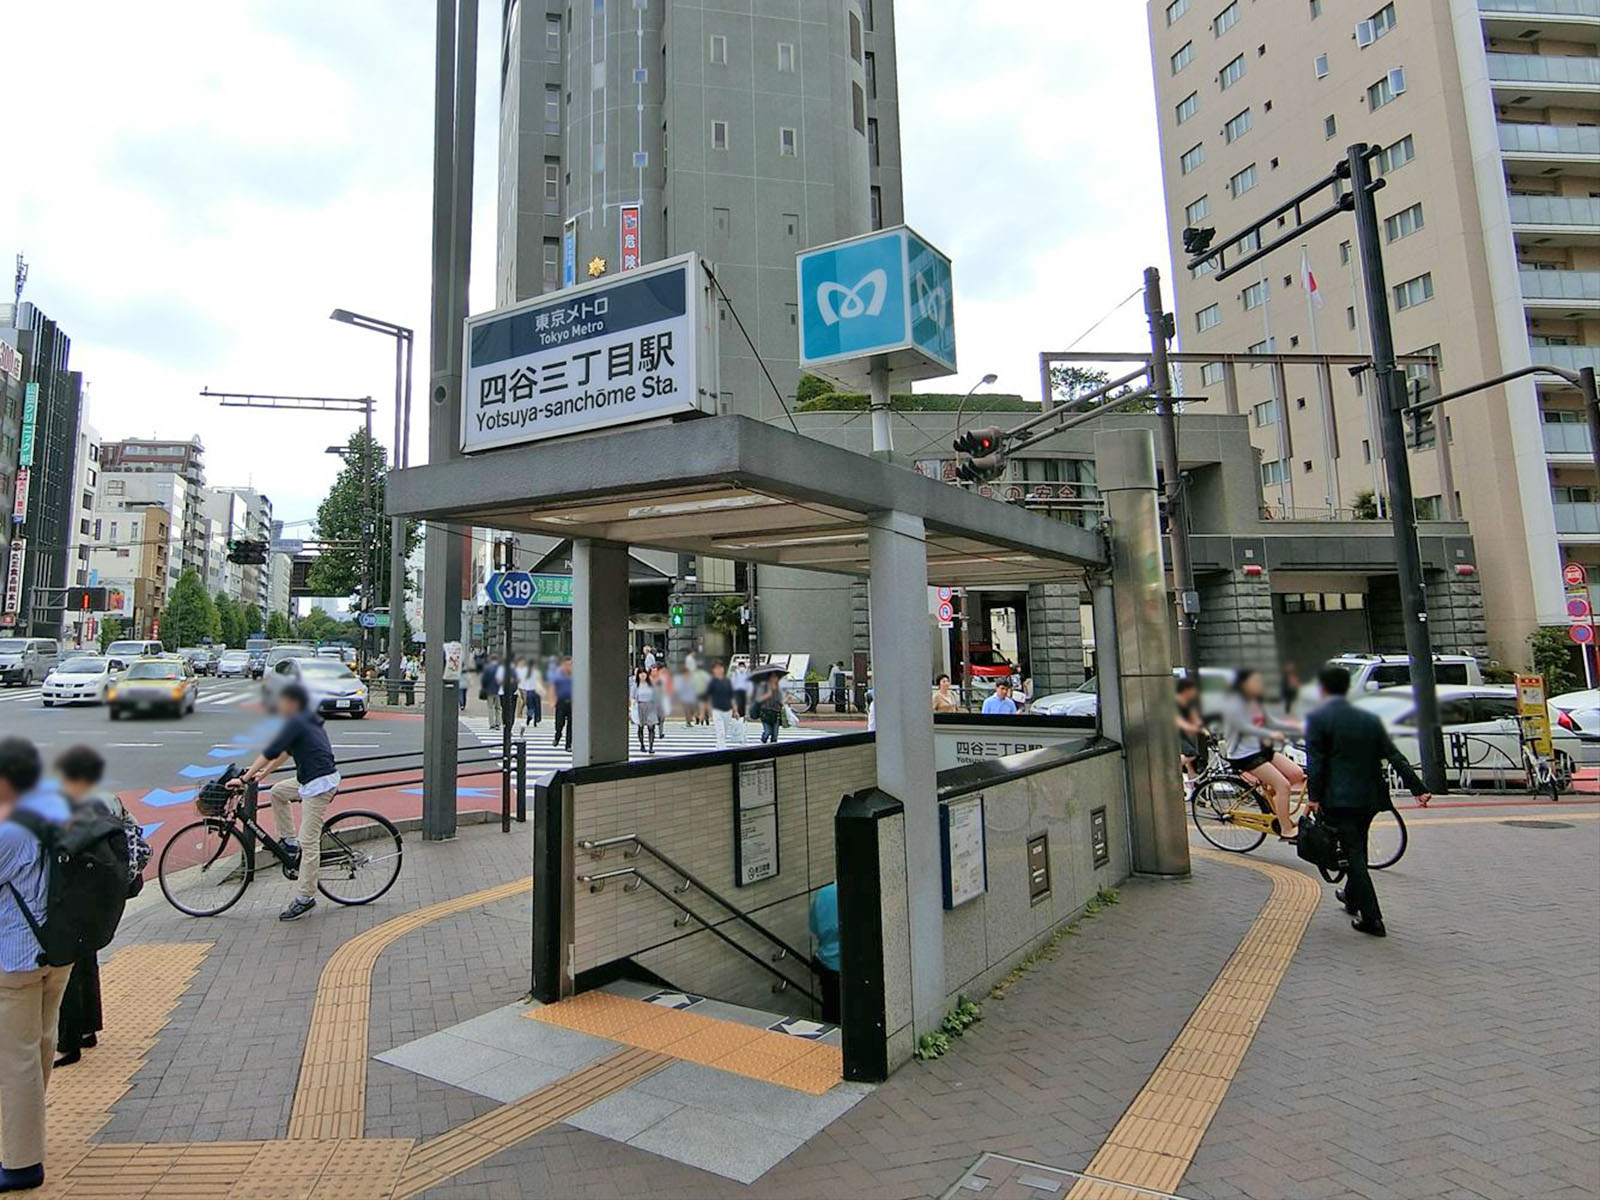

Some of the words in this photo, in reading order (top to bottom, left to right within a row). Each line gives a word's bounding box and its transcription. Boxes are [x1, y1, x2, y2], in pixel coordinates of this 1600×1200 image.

[535, 297, 608, 332] 東京メトロ
[540, 330, 569, 345] Tokyo
[572, 321, 604, 337] Metro
[480, 331, 675, 409] 四谷三丁目駅
[476, 386, 636, 432] Yotsuya-sanchōme
[641, 375, 678, 399] Sta.
[502, 580, 531, 599] 319
